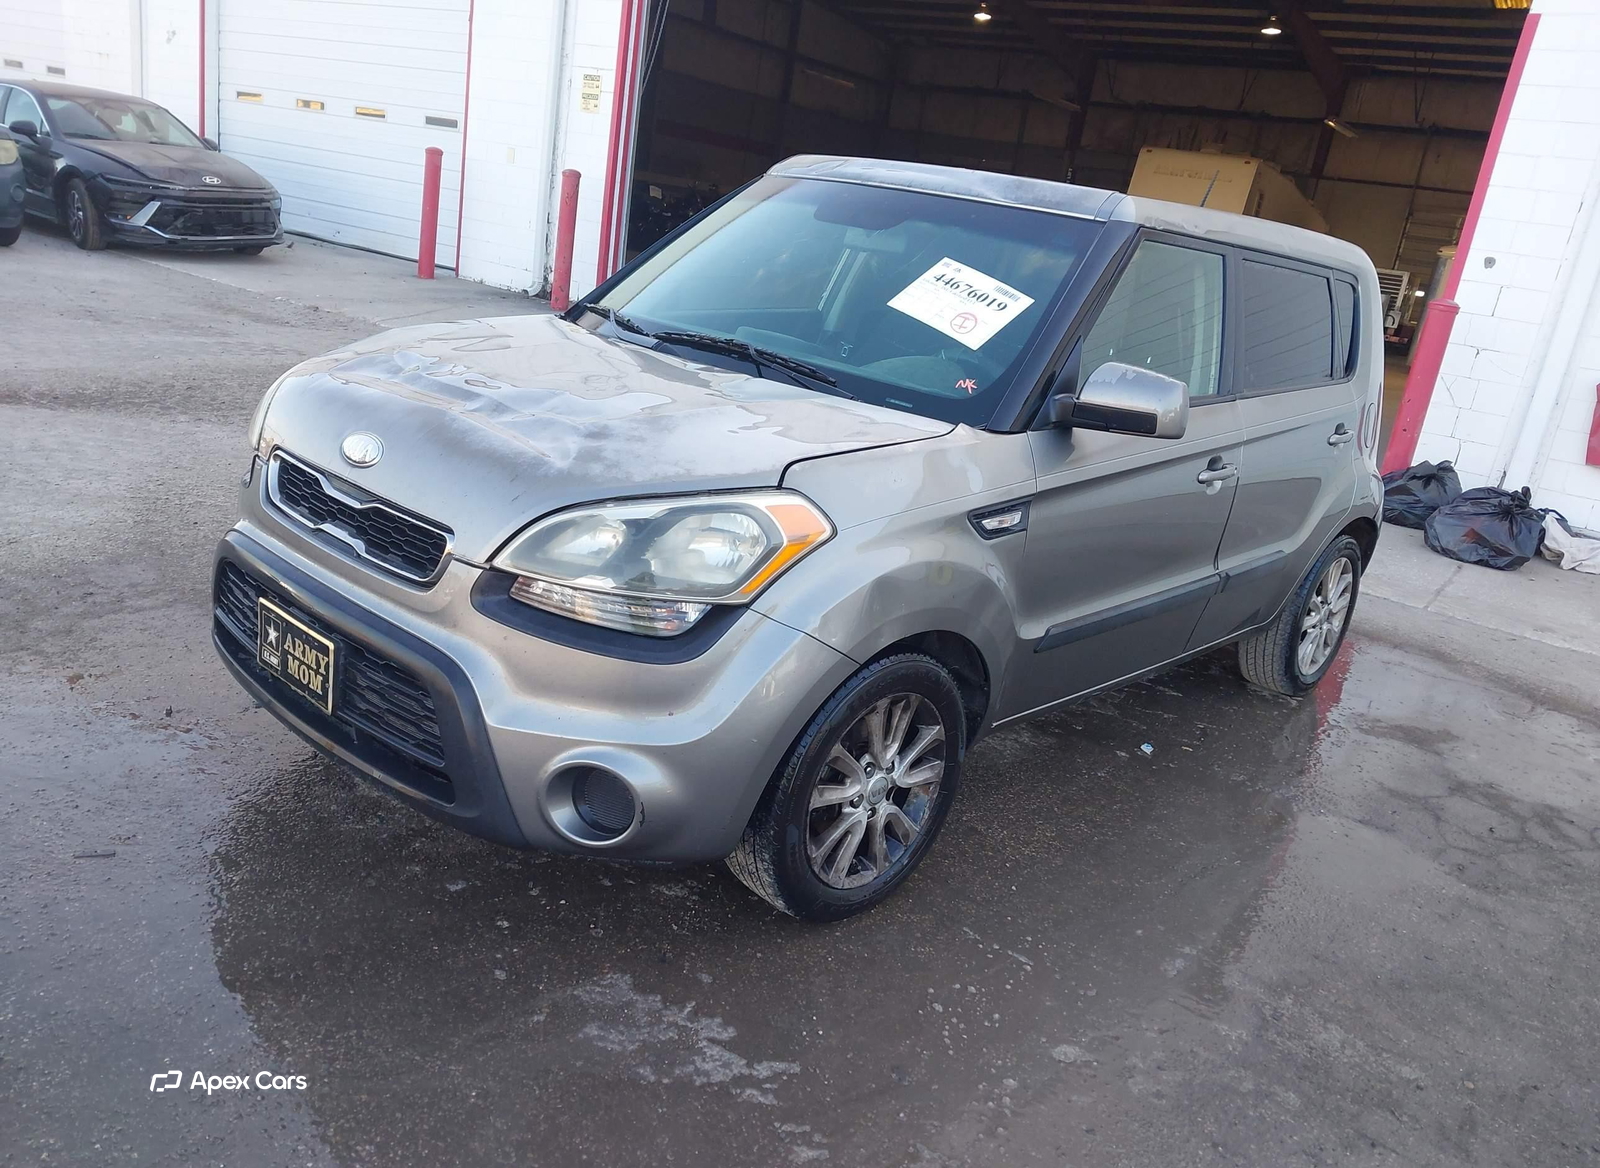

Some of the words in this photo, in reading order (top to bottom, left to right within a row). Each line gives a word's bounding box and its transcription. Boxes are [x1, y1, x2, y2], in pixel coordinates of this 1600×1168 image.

[933, 273, 1008, 312] 44676019
[283, 632, 328, 675] ARMY
[287, 654, 323, 695] MOM
